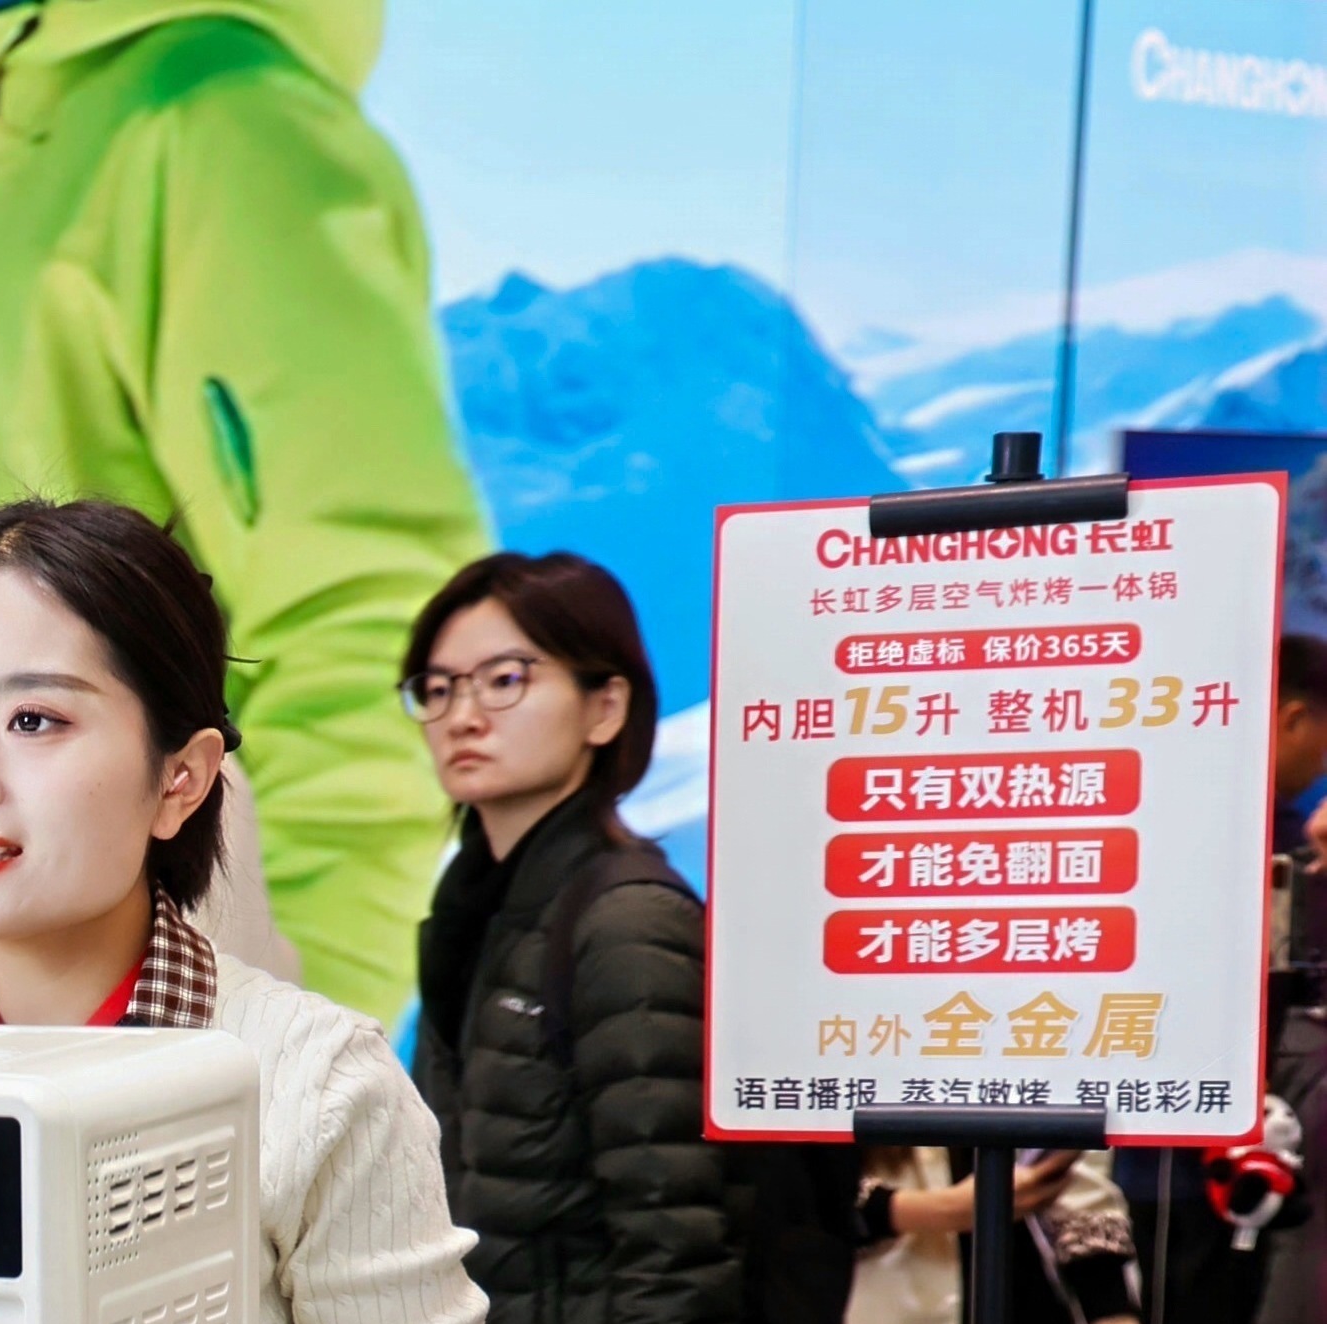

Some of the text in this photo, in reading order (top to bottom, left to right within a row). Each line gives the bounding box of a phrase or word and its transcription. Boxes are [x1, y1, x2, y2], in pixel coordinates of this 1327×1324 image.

[816, 518, 1175, 568] CHANGHONG 长虹
[810, 570, 1179, 616] 长虹多层空气炸烤一体锅
[847, 631, 1131, 668] 拒绝虚标 保价365天
[742, 675, 1240, 742] 内胆15升 整机33升
[860, 761, 1108, 811] 只有双热源
[858, 840, 1104, 889] 才能免翻面
[856, 918, 1102, 965] 才能多层烤
[816, 990, 1167, 1059] 内外全金属
[733, 1076, 1234, 1114] 语音播报 蒸汽嫩烤 智能彩屏
